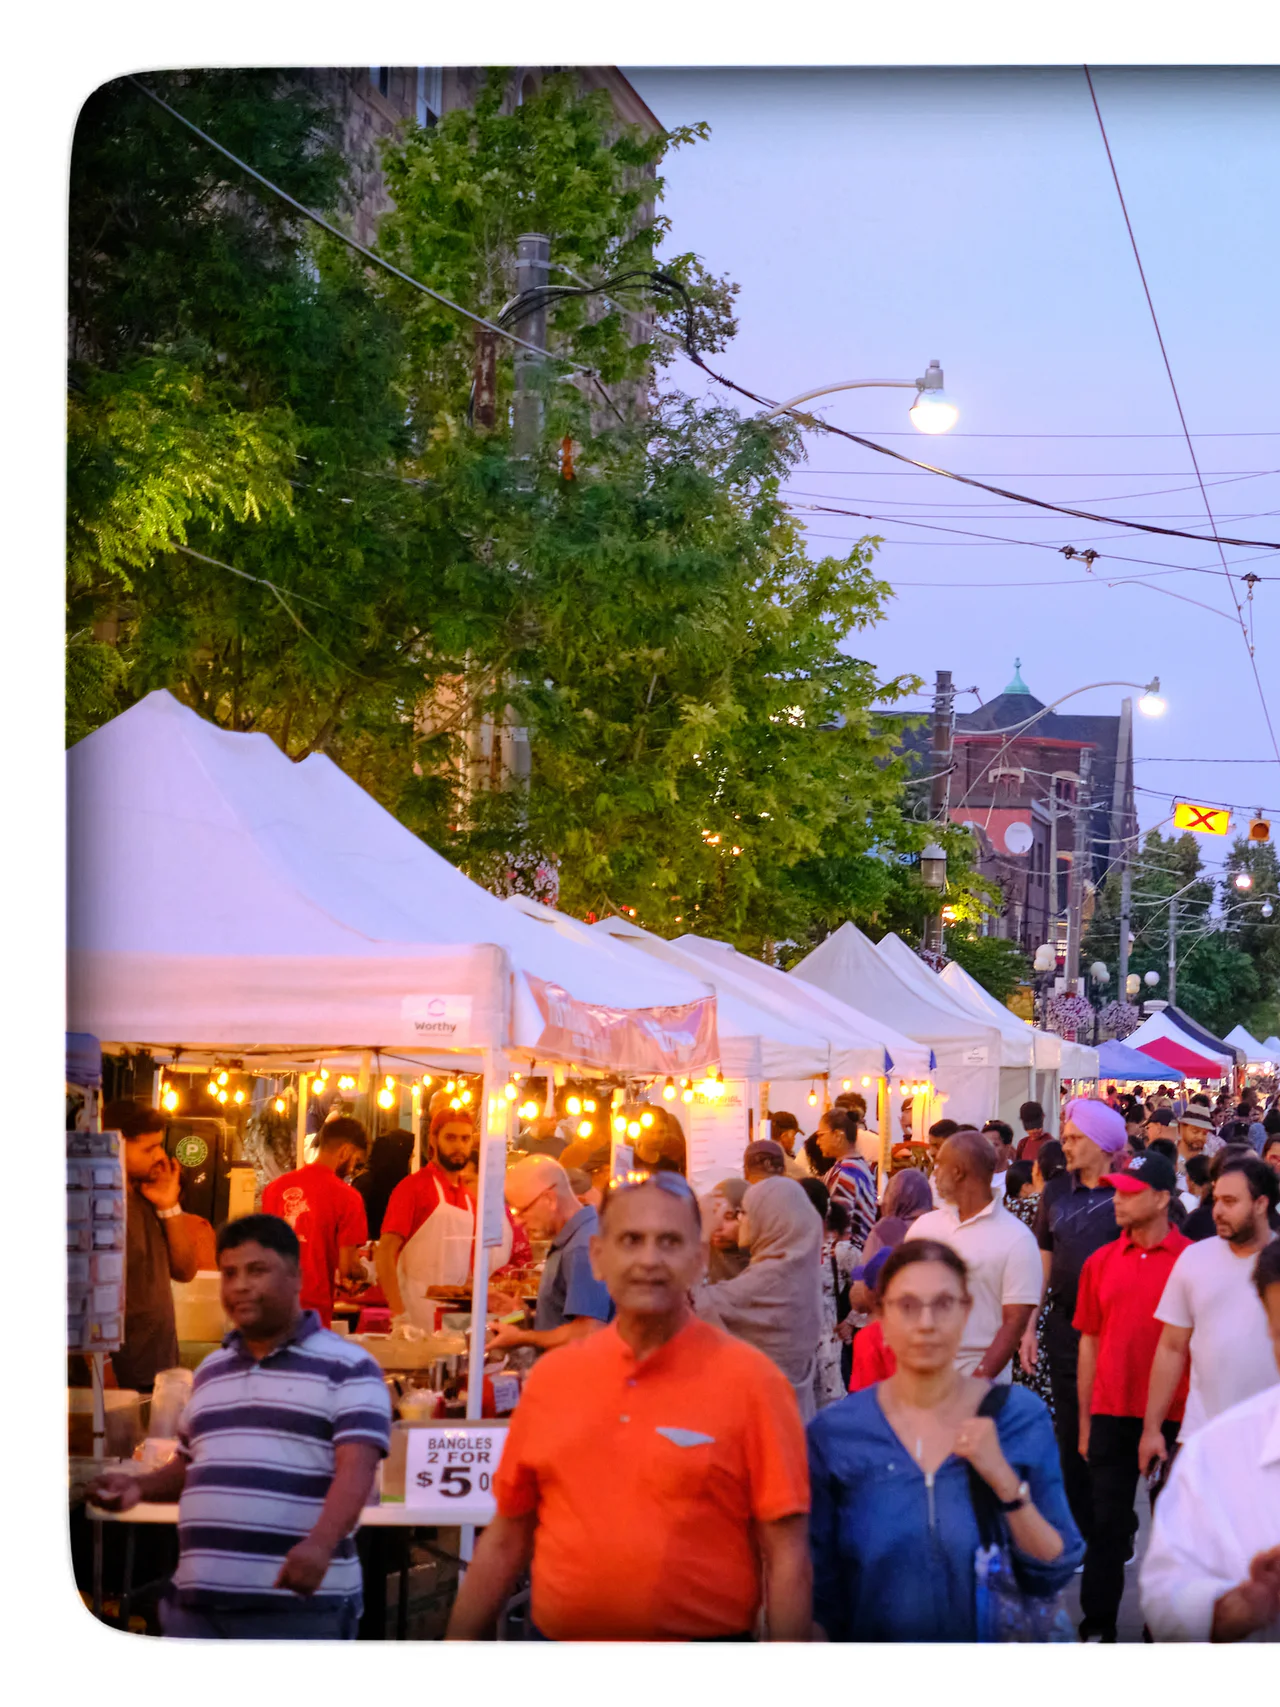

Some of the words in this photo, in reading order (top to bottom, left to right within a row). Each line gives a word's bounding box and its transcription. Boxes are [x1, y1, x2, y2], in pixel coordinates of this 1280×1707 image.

[414, 1021, 457, 1033] Worthy
[428, 1438, 492, 1450] BANGLES
[427, 1452, 439, 1464] 2
[447, 1452, 490, 1464] FOR
